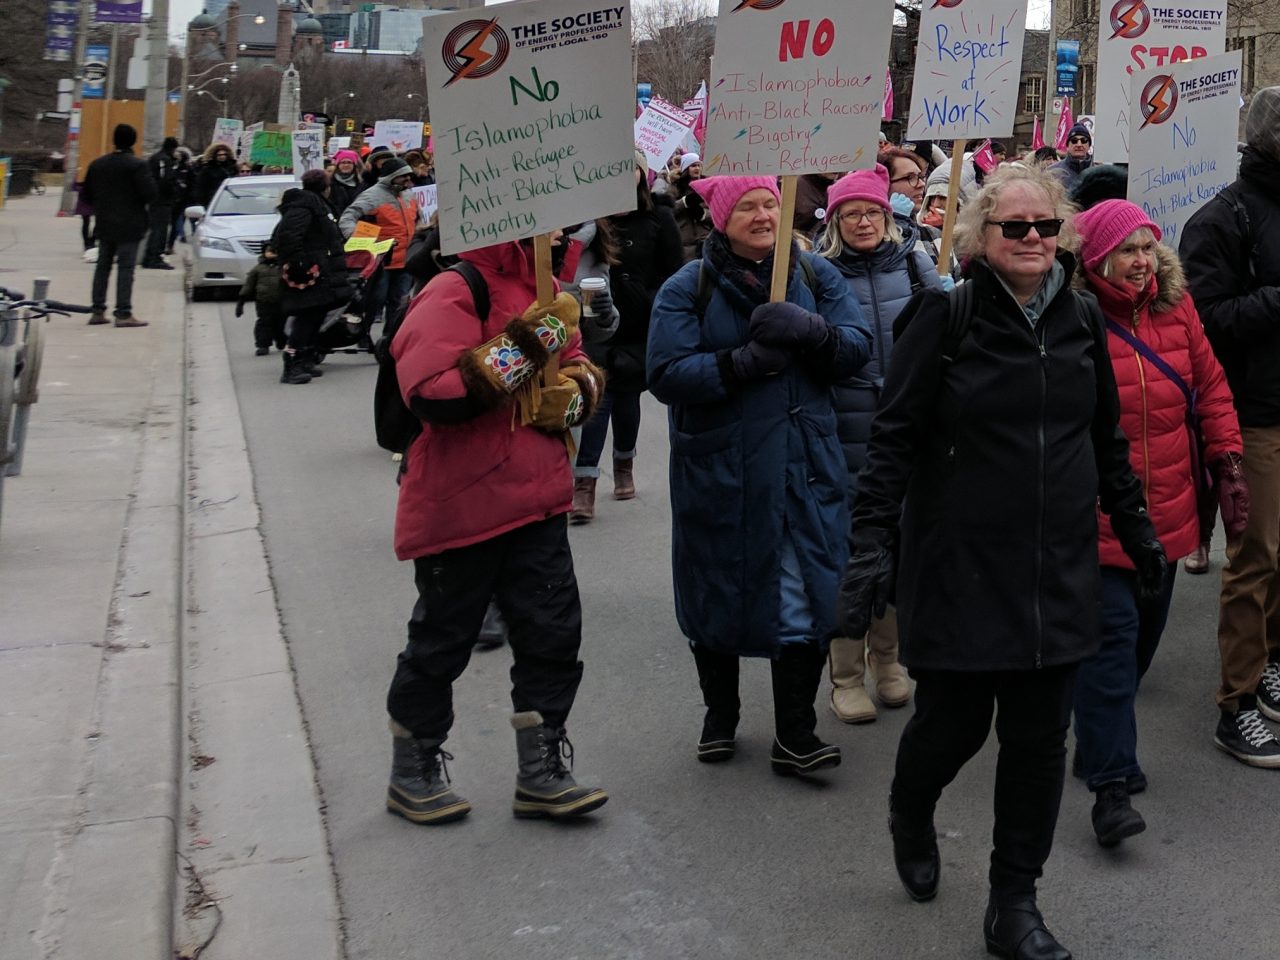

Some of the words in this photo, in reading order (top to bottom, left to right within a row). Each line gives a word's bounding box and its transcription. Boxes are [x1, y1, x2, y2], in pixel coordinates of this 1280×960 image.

[511, 21, 547, 39] THE
[551, 6, 624, 33] SOCIETY
[1152, 8, 1174, 17] THE
[1177, 9, 1223, 20] SOCIETY
[528, 34, 559, 46] ENERGY
[560, 21, 623, 38] PROFESSIONALS
[531, 42, 557, 53] IFPTE
[558, 37, 589, 47] LOCAL
[779, 18, 835, 62] NO
[936, 24, 1009, 68] Respect
[1126, 44, 1207, 75] STOP
[509, 66, 559, 105] No
[727, 66, 865, 97] Islamophobia
[961, 68, 976, 90] at
[1180, 79, 1198, 92] THE
[1199, 69, 1239, 87] SOCIETY
[714, 98, 813, 121] Anti-Black
[822, 98, 873, 116] Racism
[923, 90, 990, 127] Work
[448, 104, 603, 155] Islamophobia
[749, 125, 812, 151] Bigotry
[1173, 116, 1196, 150] No
[459, 145, 578, 191] Anti-Refugee
[780, 146, 851, 171] Refugee
[461, 174, 572, 218] Anti-Black
[573, 158, 635, 185] Racism
[1141, 157, 1217, 194] Islamophobia
[460, 209, 536, 244] Bigotry
